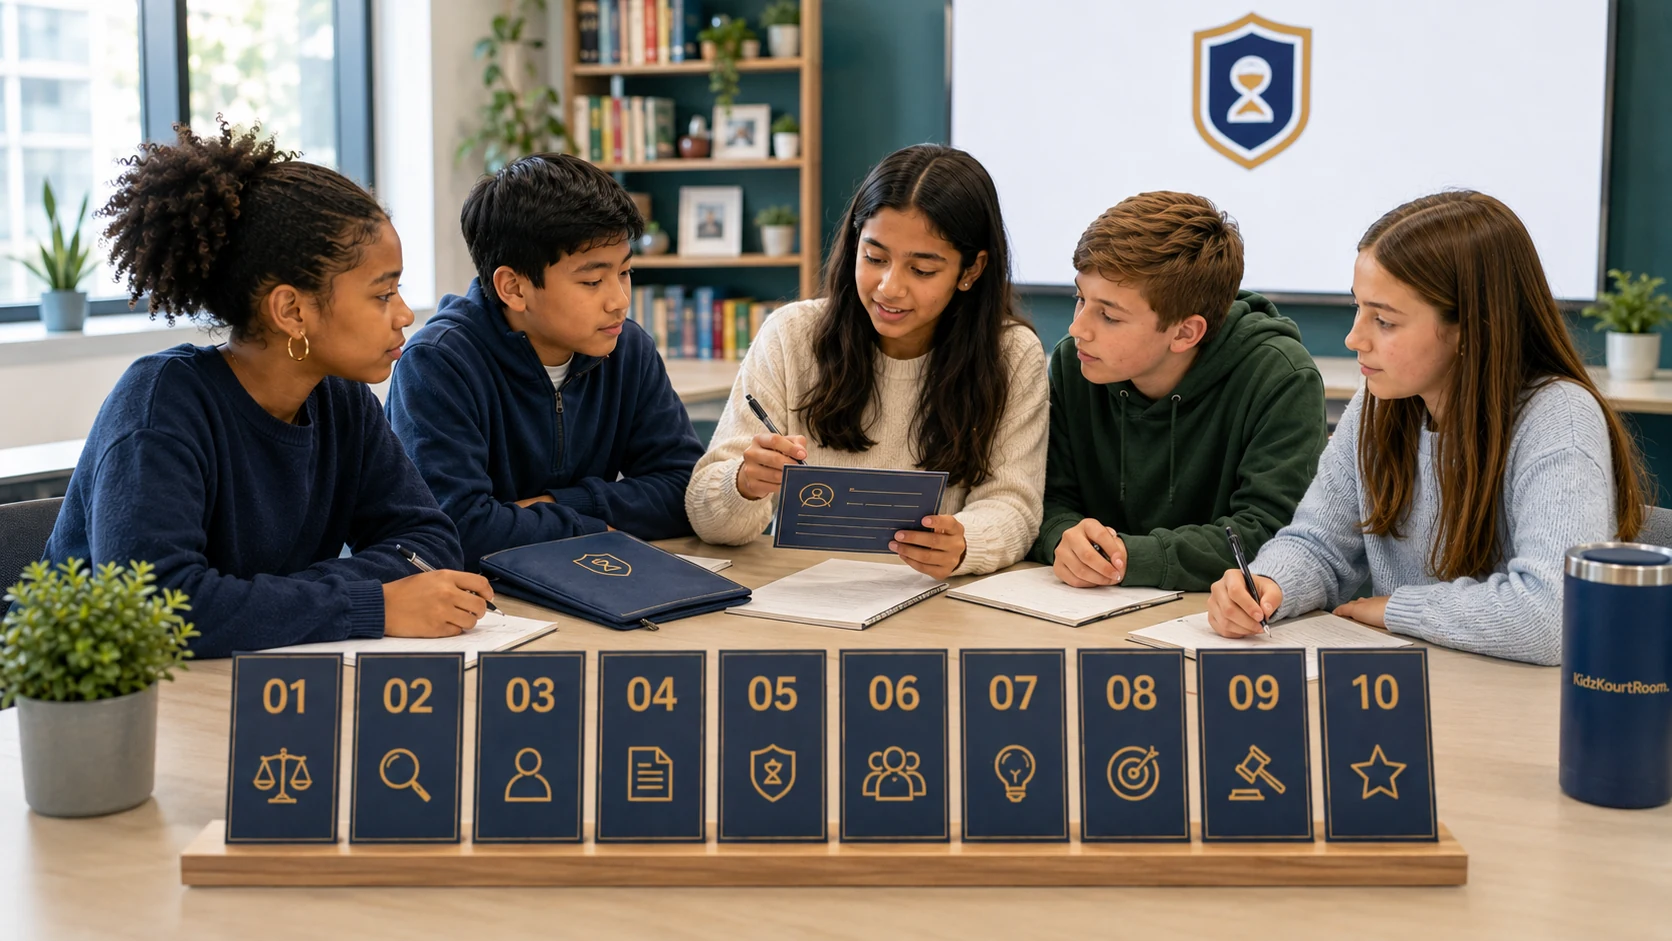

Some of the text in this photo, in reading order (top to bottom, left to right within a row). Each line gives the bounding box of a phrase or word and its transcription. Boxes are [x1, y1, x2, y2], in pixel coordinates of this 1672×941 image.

[262, 678, 306, 714] 01
[383, 677, 433, 714] 02
[505, 677, 555, 713] 03
[626, 676, 678, 712] 04
[747, 675, 798, 711] 05
[868, 674, 920, 711] 06
[989, 674, 1038, 711] 07
[1106, 674, 1157, 711] 08
[1228, 674, 1280, 711] 09
[1352, 673, 1399, 710] 10
